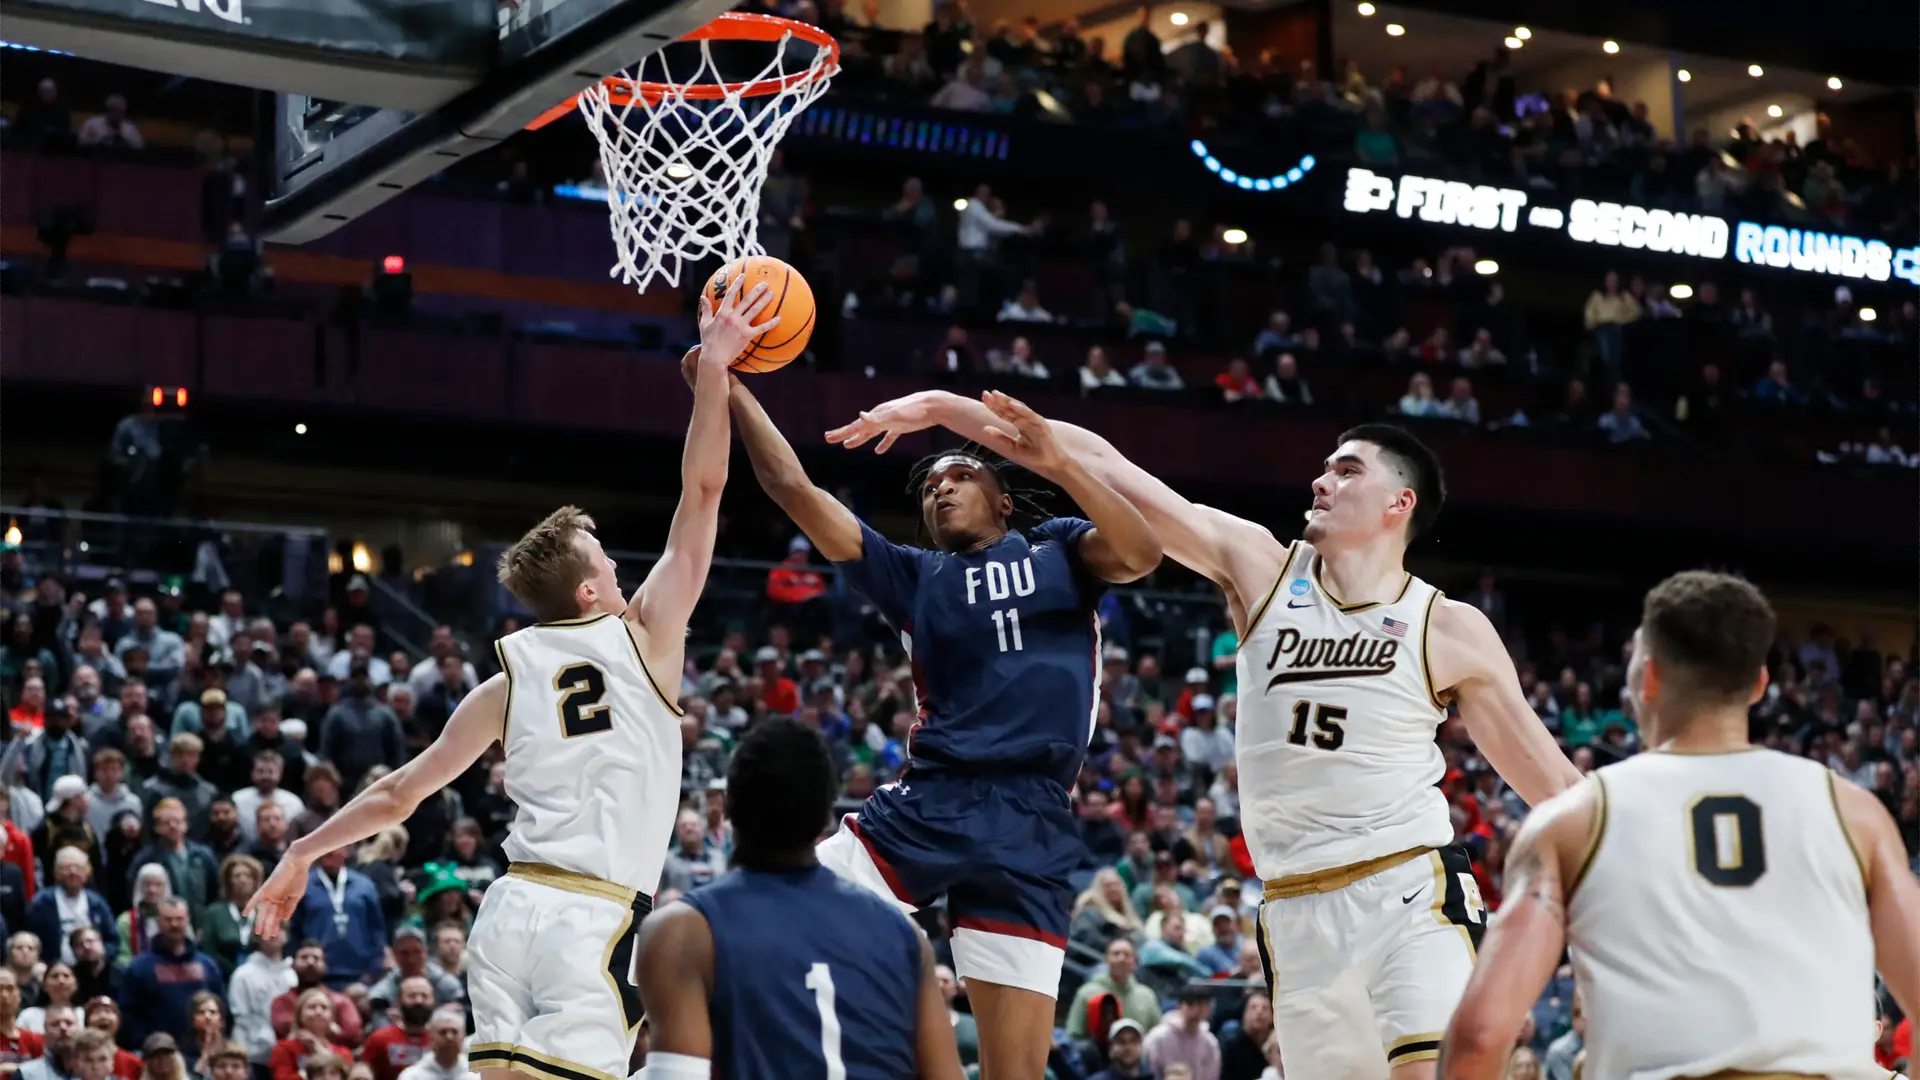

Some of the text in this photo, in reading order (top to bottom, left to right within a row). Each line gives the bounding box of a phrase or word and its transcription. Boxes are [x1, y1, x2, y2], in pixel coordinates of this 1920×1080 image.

[1396, 174, 1893, 282] FIRST SECOND ROUNDS
[965, 557, 1036, 605] FDU
[991, 608, 1023, 652] 11
[1266, 628, 1399, 676] Purdue
[552, 661, 614, 739] 2
[1287, 699, 1348, 751] 15
[1683, 791, 1768, 888] 0
[805, 962, 847, 1080] 1
